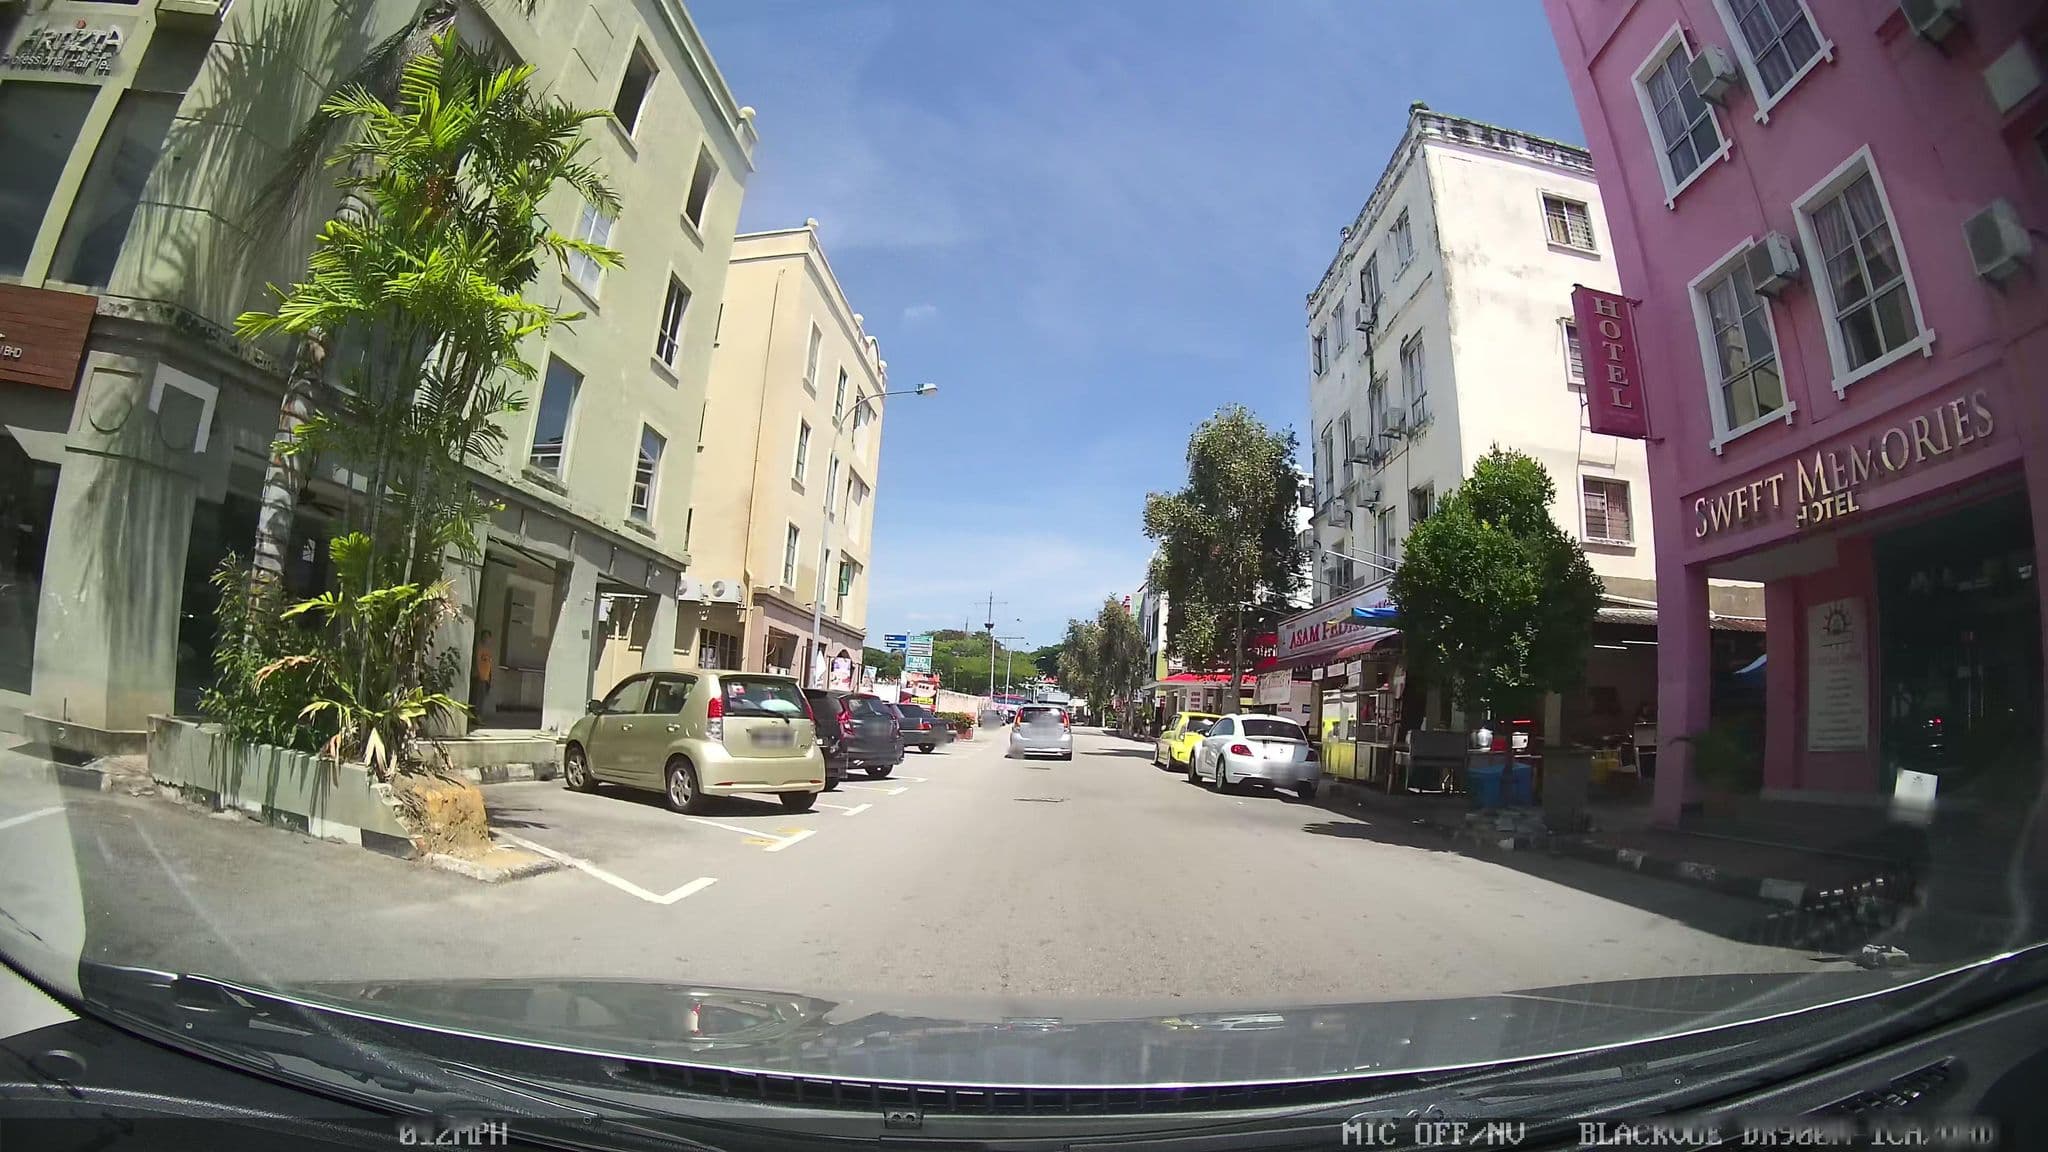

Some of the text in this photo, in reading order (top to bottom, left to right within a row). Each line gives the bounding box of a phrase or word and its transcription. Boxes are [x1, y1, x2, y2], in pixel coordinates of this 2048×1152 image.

[4, 346, 22, 358] BHD
[1592, 296, 1632, 409] HOTEL
[1796, 388, 1994, 504] MEMORIES
[1796, 490, 1860, 530] HOTEL
[1289, 624, 1320, 650] ASAM
